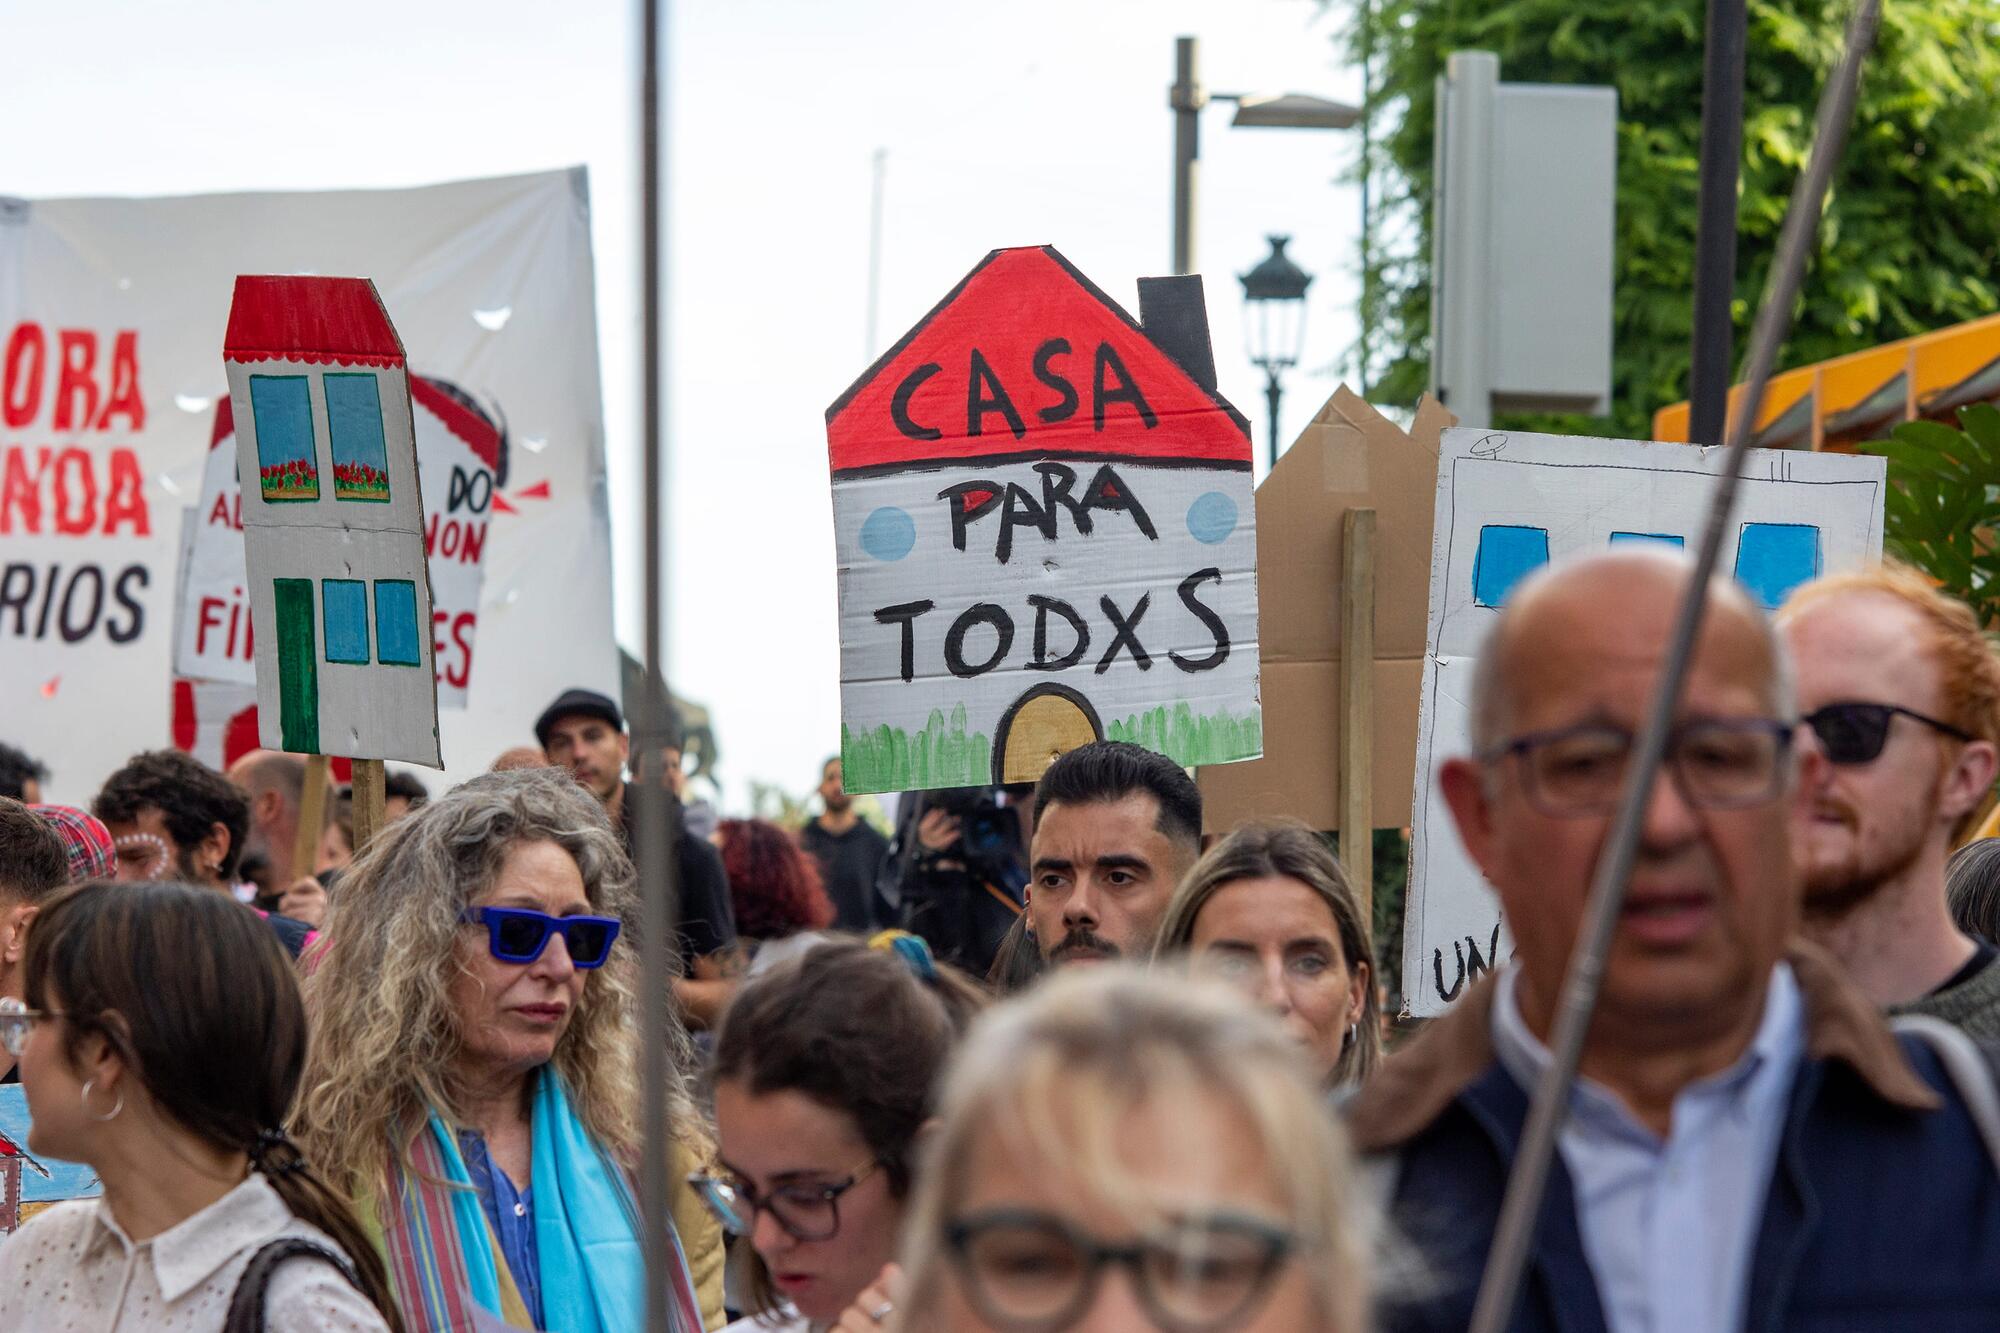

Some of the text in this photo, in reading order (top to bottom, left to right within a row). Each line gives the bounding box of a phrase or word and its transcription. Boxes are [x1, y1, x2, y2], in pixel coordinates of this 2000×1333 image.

[1, 320, 147, 432] ORA
[890, 337, 1158, 440] CASA
[937, 462, 1159, 564] PARA
[0, 563, 149, 644] RIOS
[873, 566, 1231, 683] TODXS
[1433, 922, 1518, 1003] UN
